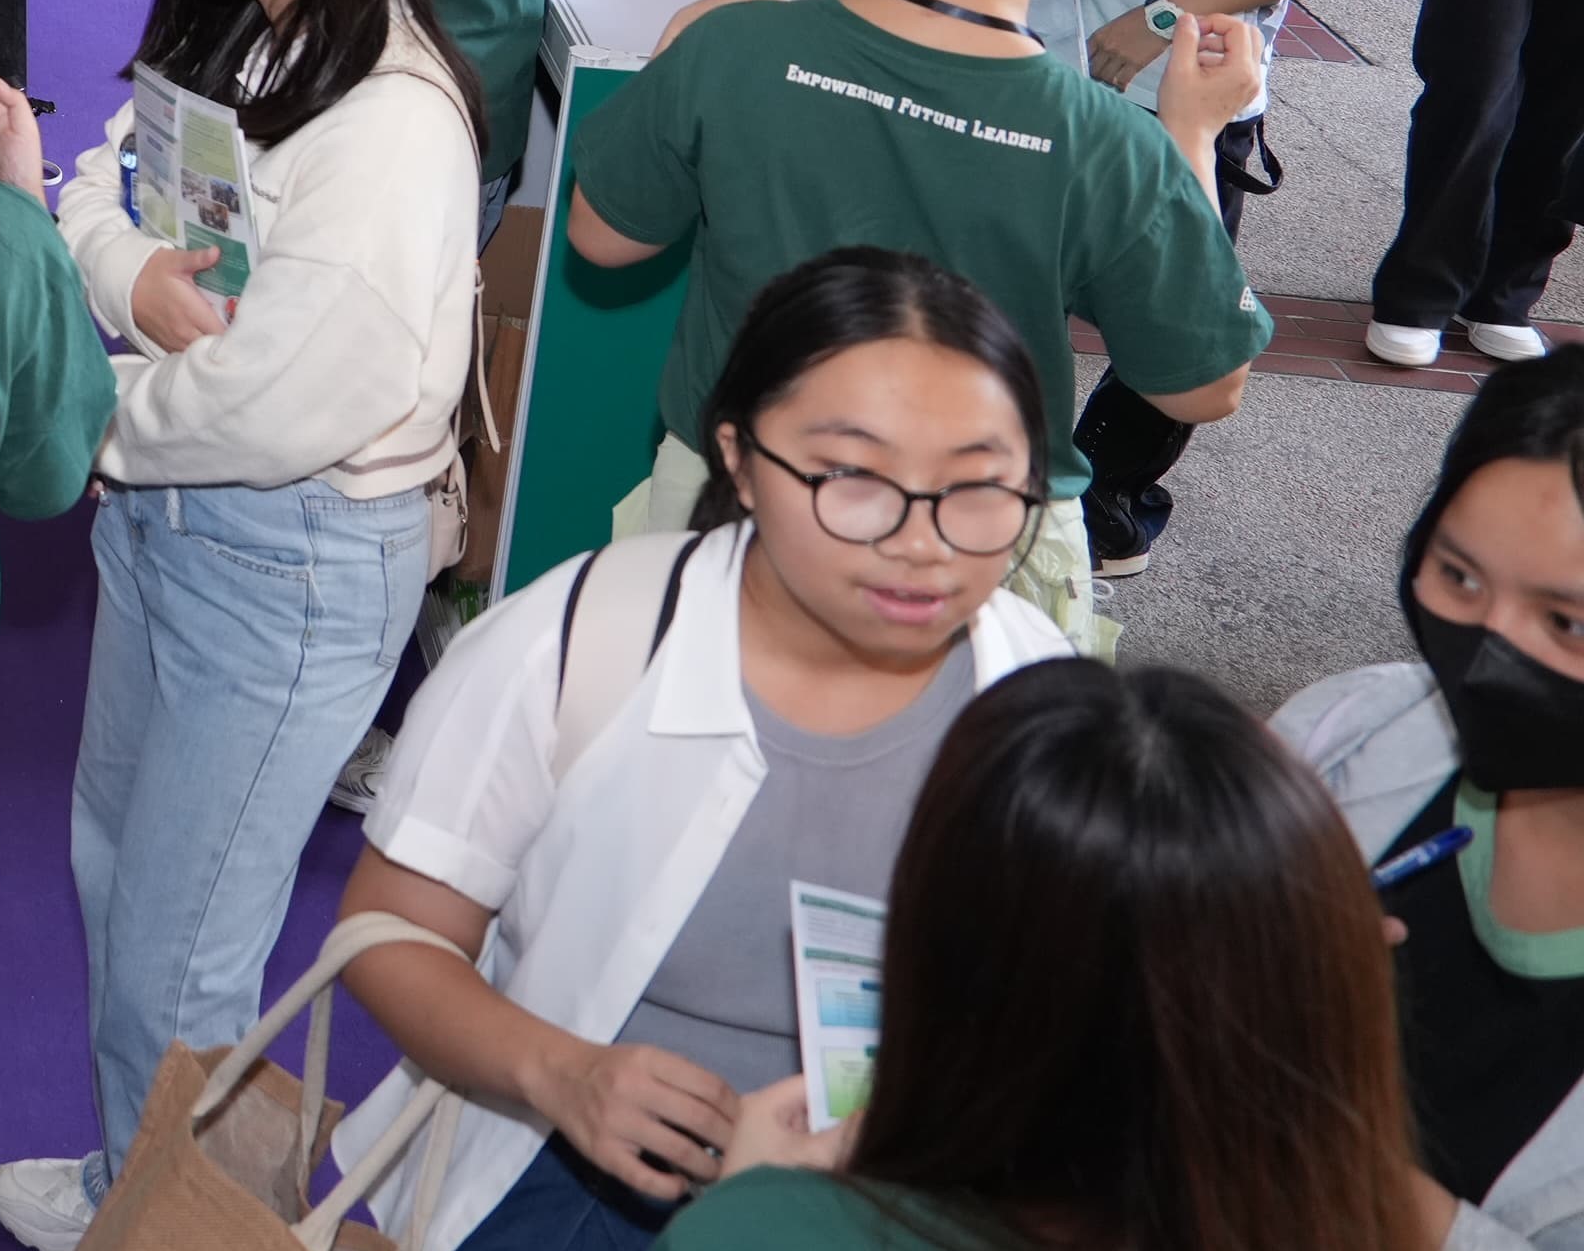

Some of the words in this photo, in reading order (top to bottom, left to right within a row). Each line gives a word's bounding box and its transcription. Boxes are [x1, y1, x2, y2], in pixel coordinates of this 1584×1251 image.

[786, 64, 895, 110] EMPOWERING
[898, 97, 967, 134] FUTURE
[972, 119, 1052, 153] LEADERS
